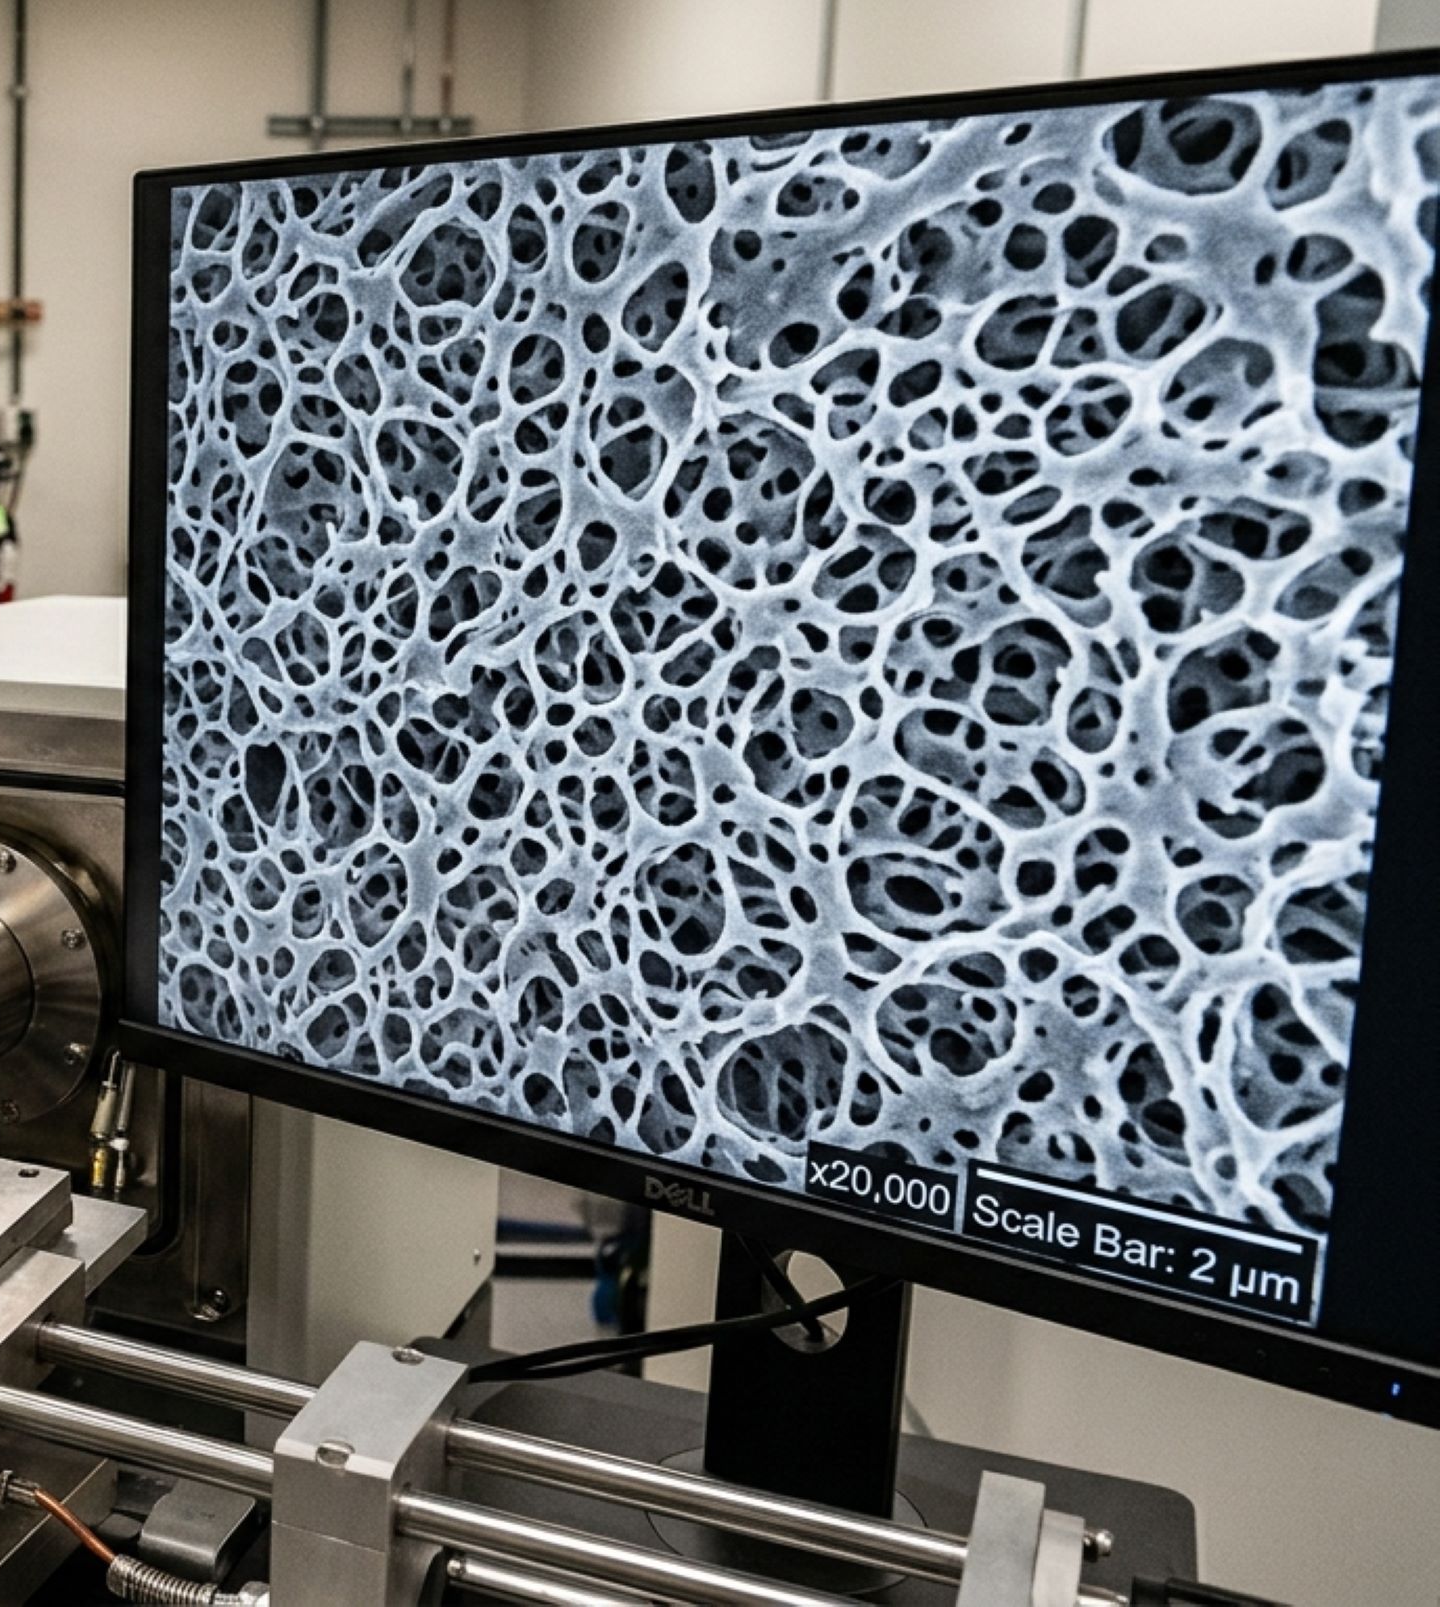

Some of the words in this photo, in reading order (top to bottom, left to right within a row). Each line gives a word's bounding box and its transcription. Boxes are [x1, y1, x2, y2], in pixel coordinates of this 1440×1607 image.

[644, 1176, 714, 1216] DELL
[810, 1160, 950, 1215] x20,000
[973, 1194, 1080, 1248] Scale
[1094, 1223, 1175, 1274] Bar:
[1189, 1248, 1217, 1284] 2
[1229, 1264, 1300, 1305] µm
